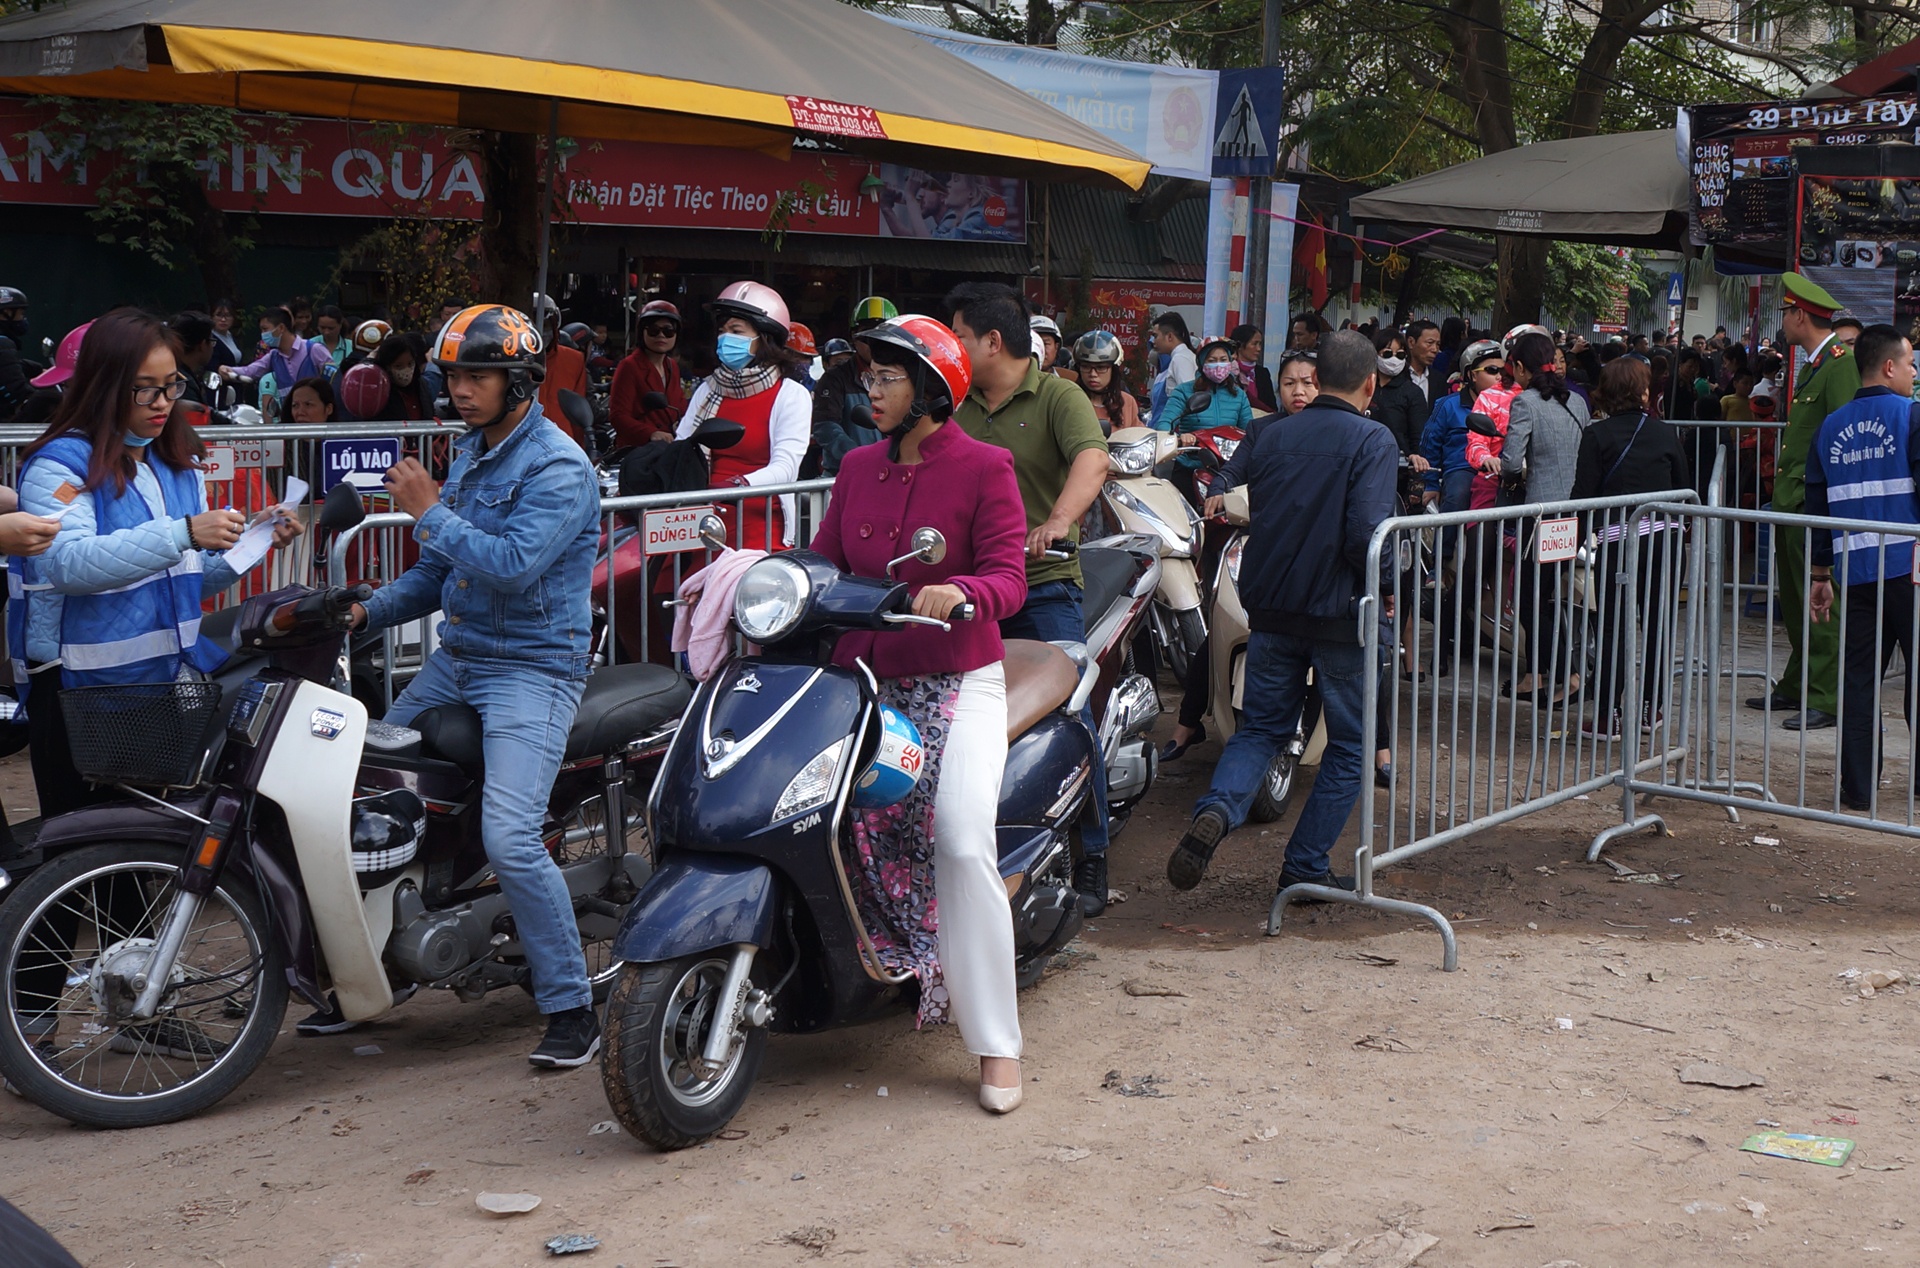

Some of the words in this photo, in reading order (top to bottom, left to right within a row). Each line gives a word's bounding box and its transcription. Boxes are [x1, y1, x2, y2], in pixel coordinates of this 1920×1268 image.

[814, 112, 840, 127] 0978
[841, 116, 861, 130] 003
[862, 119, 881, 133] 041
[1746, 108, 1780, 131] 39
[1860, 98, 1918, 127] Tây
[567, 179, 622, 213] Nhận
[629, 181, 667, 214] Đặt
[673, 183, 714, 216] Tiệc
[721, 186, 768, 213] Theo
[331, 446, 357, 470] LỐI
[361, 447, 392, 469] VÀO
[665, 513, 697, 524] C.A.H.N
[649, 525, 687, 544] DỪNG
[792, 811, 822, 835] SYM
